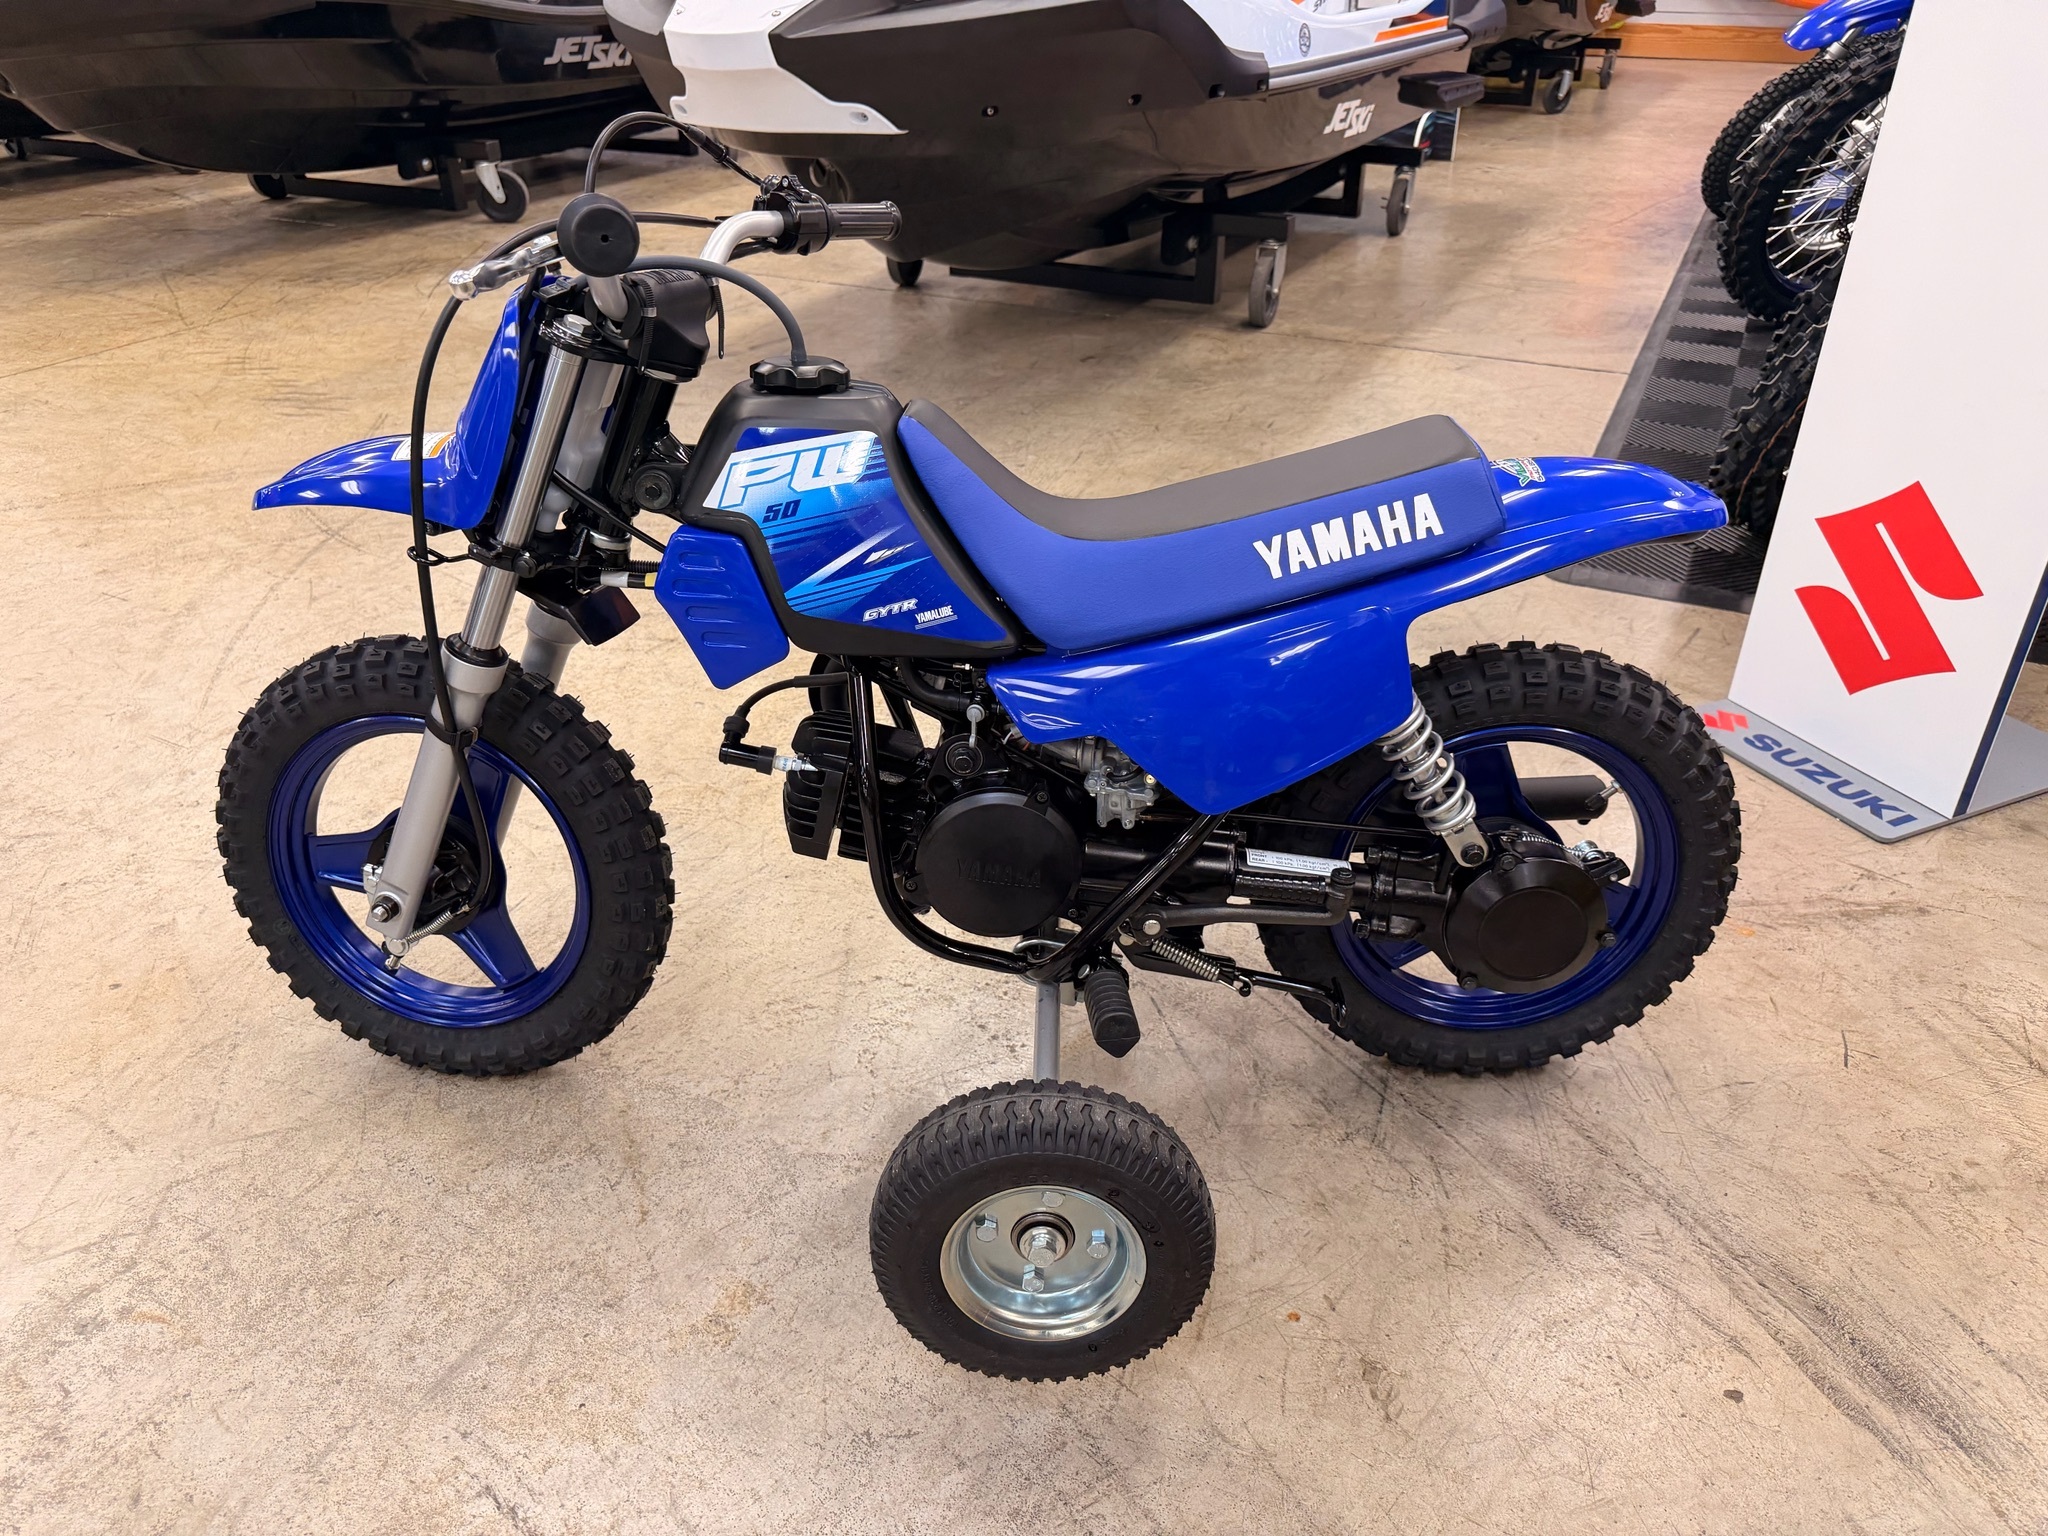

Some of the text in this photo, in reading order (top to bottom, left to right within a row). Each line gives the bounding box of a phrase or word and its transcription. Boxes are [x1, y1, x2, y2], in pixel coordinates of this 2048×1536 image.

[543, 35, 603, 65] JET
[1323, 99, 1362, 135] JET
[718, 438, 874, 509] PW
[762, 499, 802, 524] 50
[1252, 492, 1445, 580] YAMAHA
[862, 597, 919, 623] GYTR
[914, 605, 955, 624] YAMALUBE
[1743, 733, 1918, 828] SUZUKI
